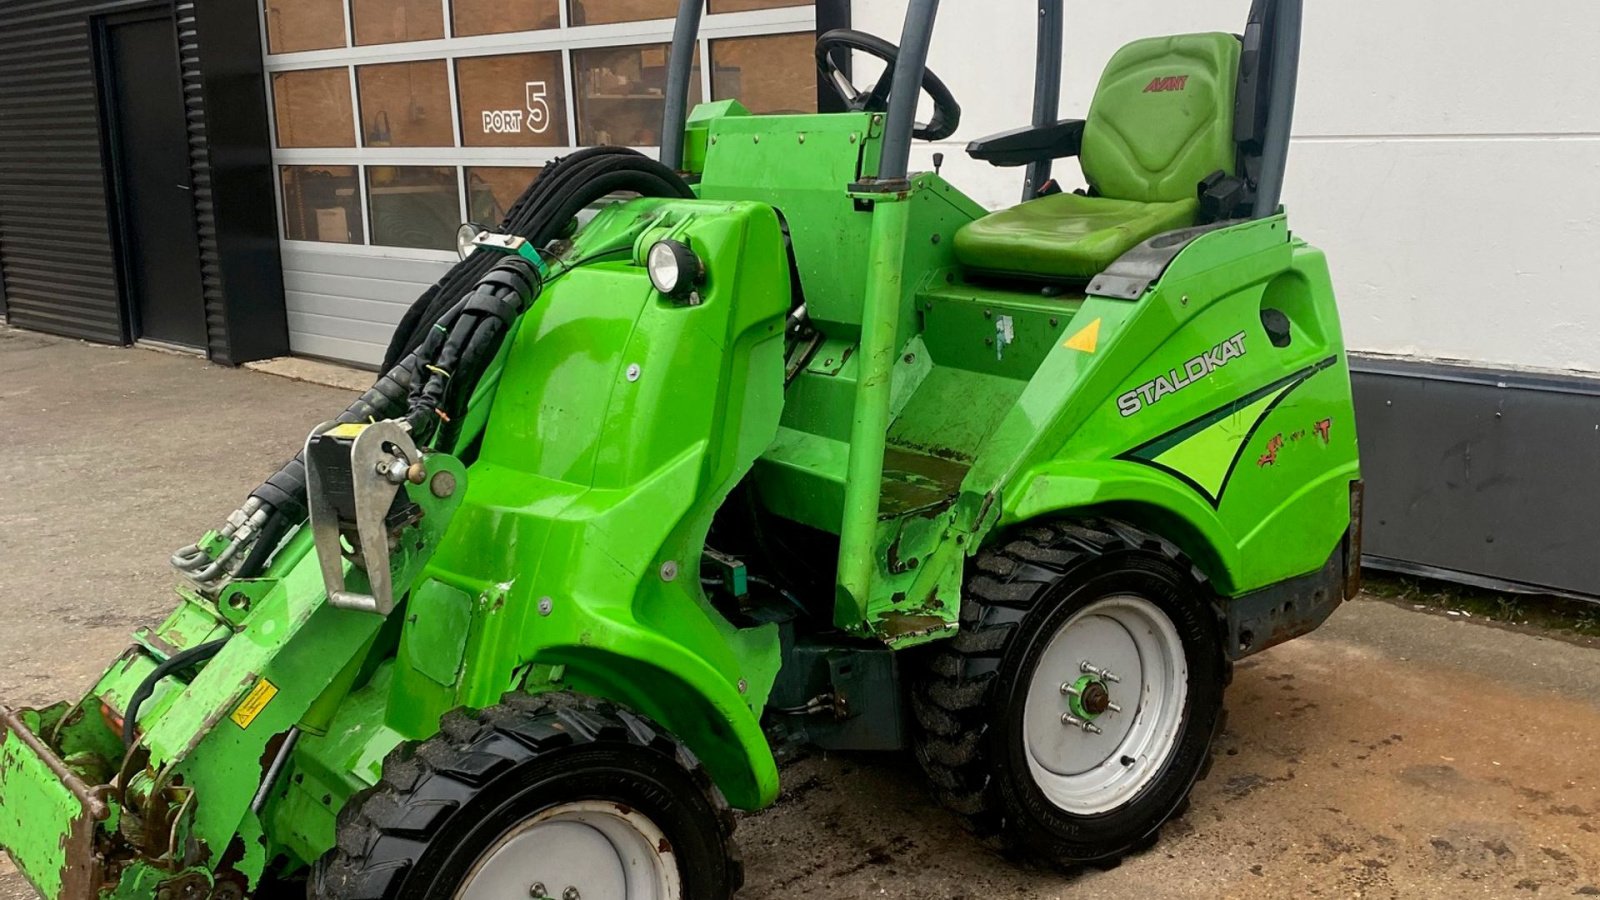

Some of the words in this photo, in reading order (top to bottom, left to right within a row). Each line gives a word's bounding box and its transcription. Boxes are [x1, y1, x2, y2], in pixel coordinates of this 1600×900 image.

[482, 110, 522, 133] PORT
[526, 81, 549, 133] 5
[1142, 75, 1189, 93] AVANT
[1117, 330, 1246, 417] STALDKAT
